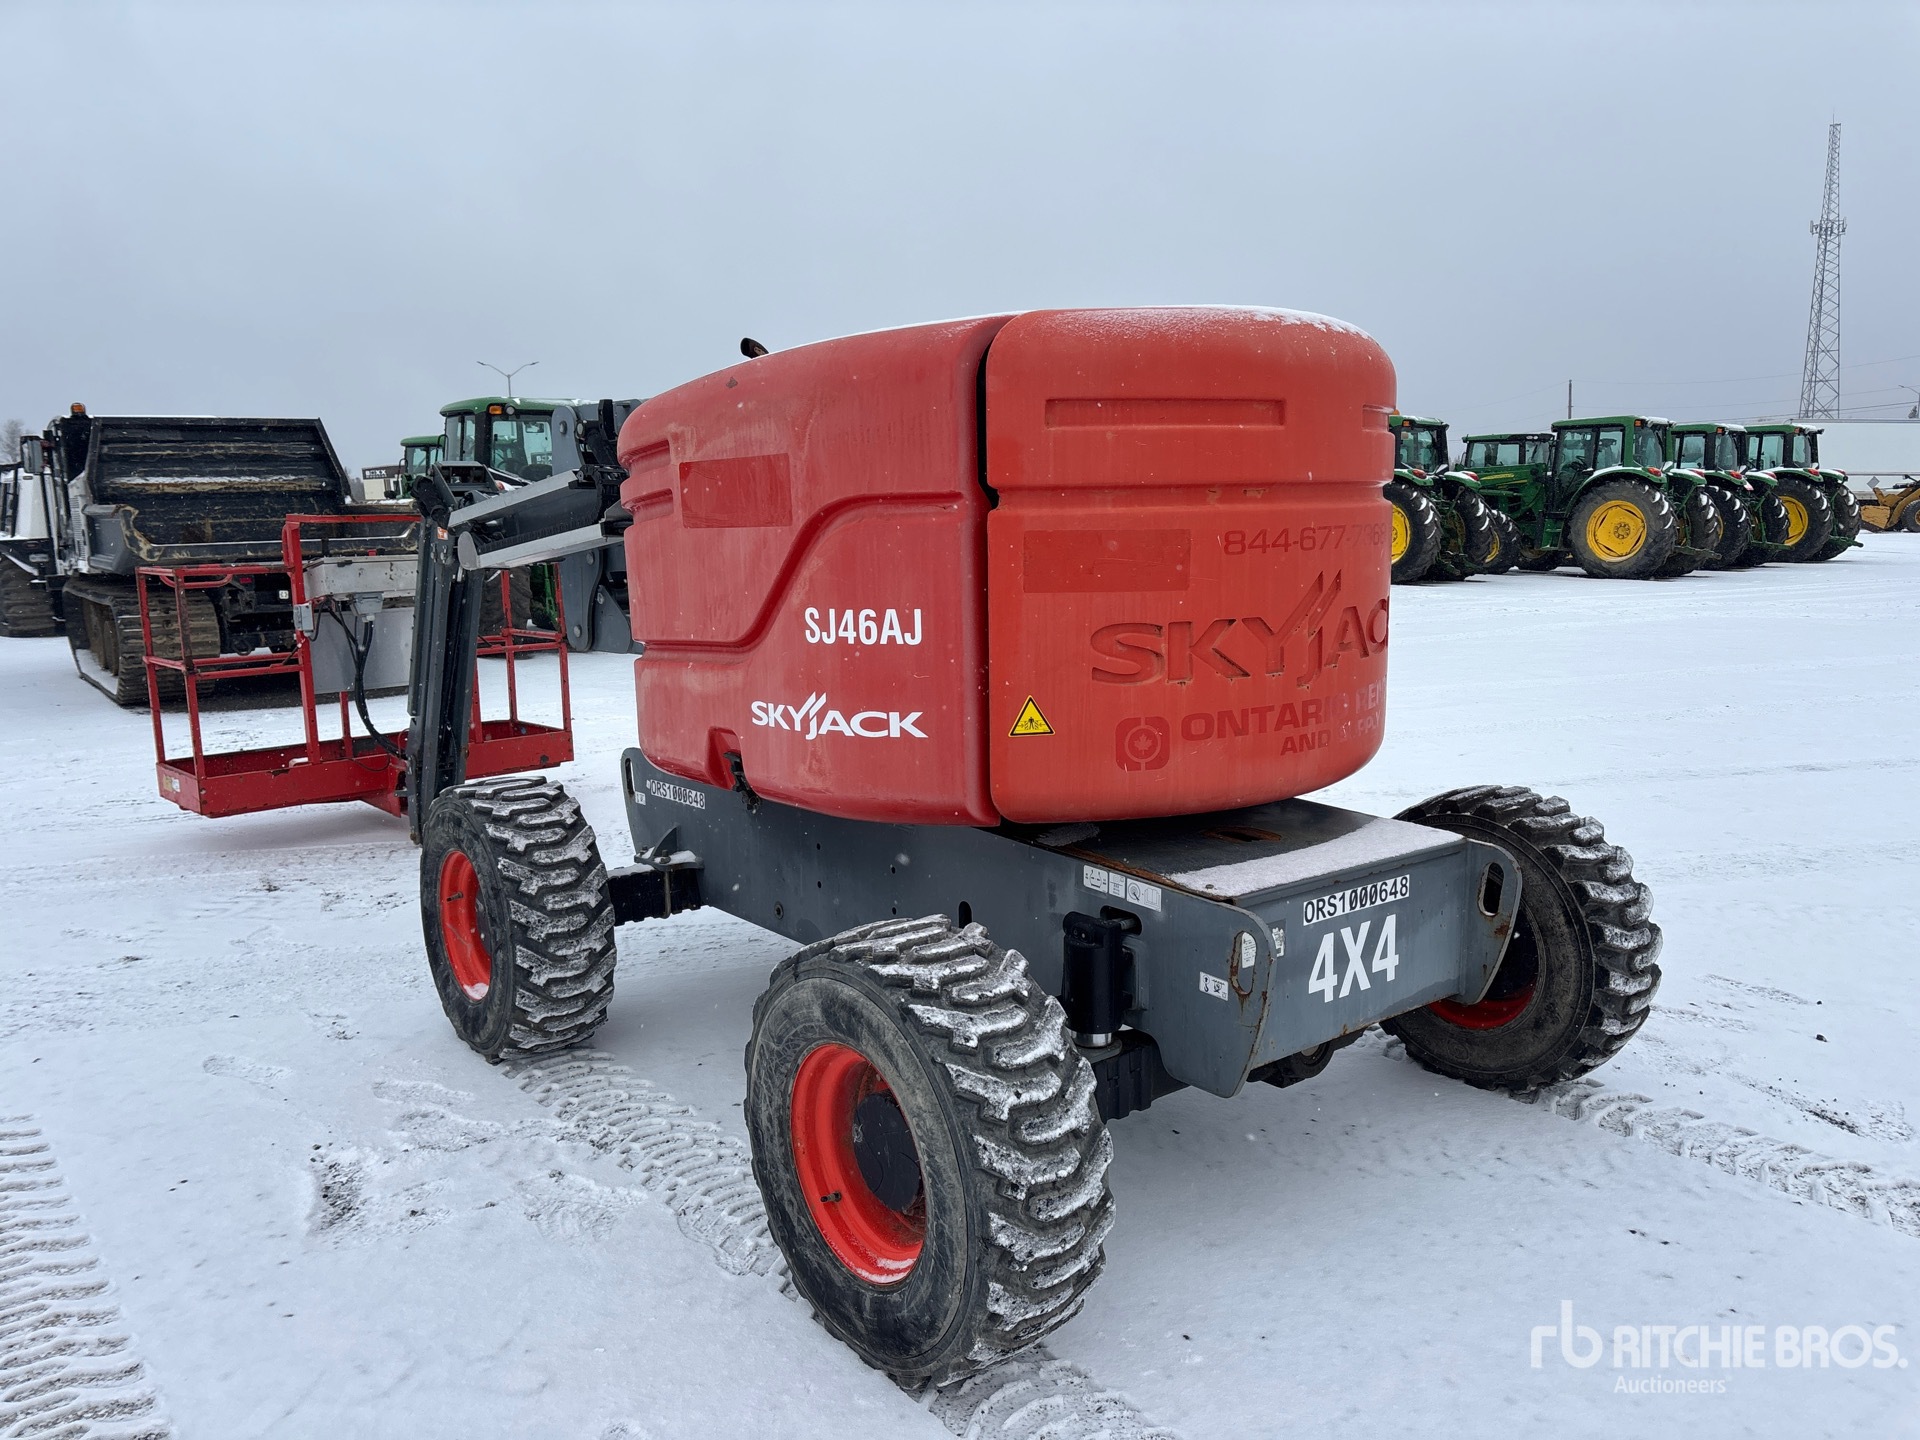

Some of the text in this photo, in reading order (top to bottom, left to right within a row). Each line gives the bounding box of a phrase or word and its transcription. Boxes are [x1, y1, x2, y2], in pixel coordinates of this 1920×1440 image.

[804, 606, 922, 645] SJ46AJ
[750, 690, 929, 741] SKYJACK
[1181, 692, 1350, 742] ONTARIO
[1280, 728, 1331, 756] AND
[651, 780, 705, 808] ORS1000648
[1304, 875, 1409, 923] ORS1000648
[1308, 914, 1399, 1003] 4X4
